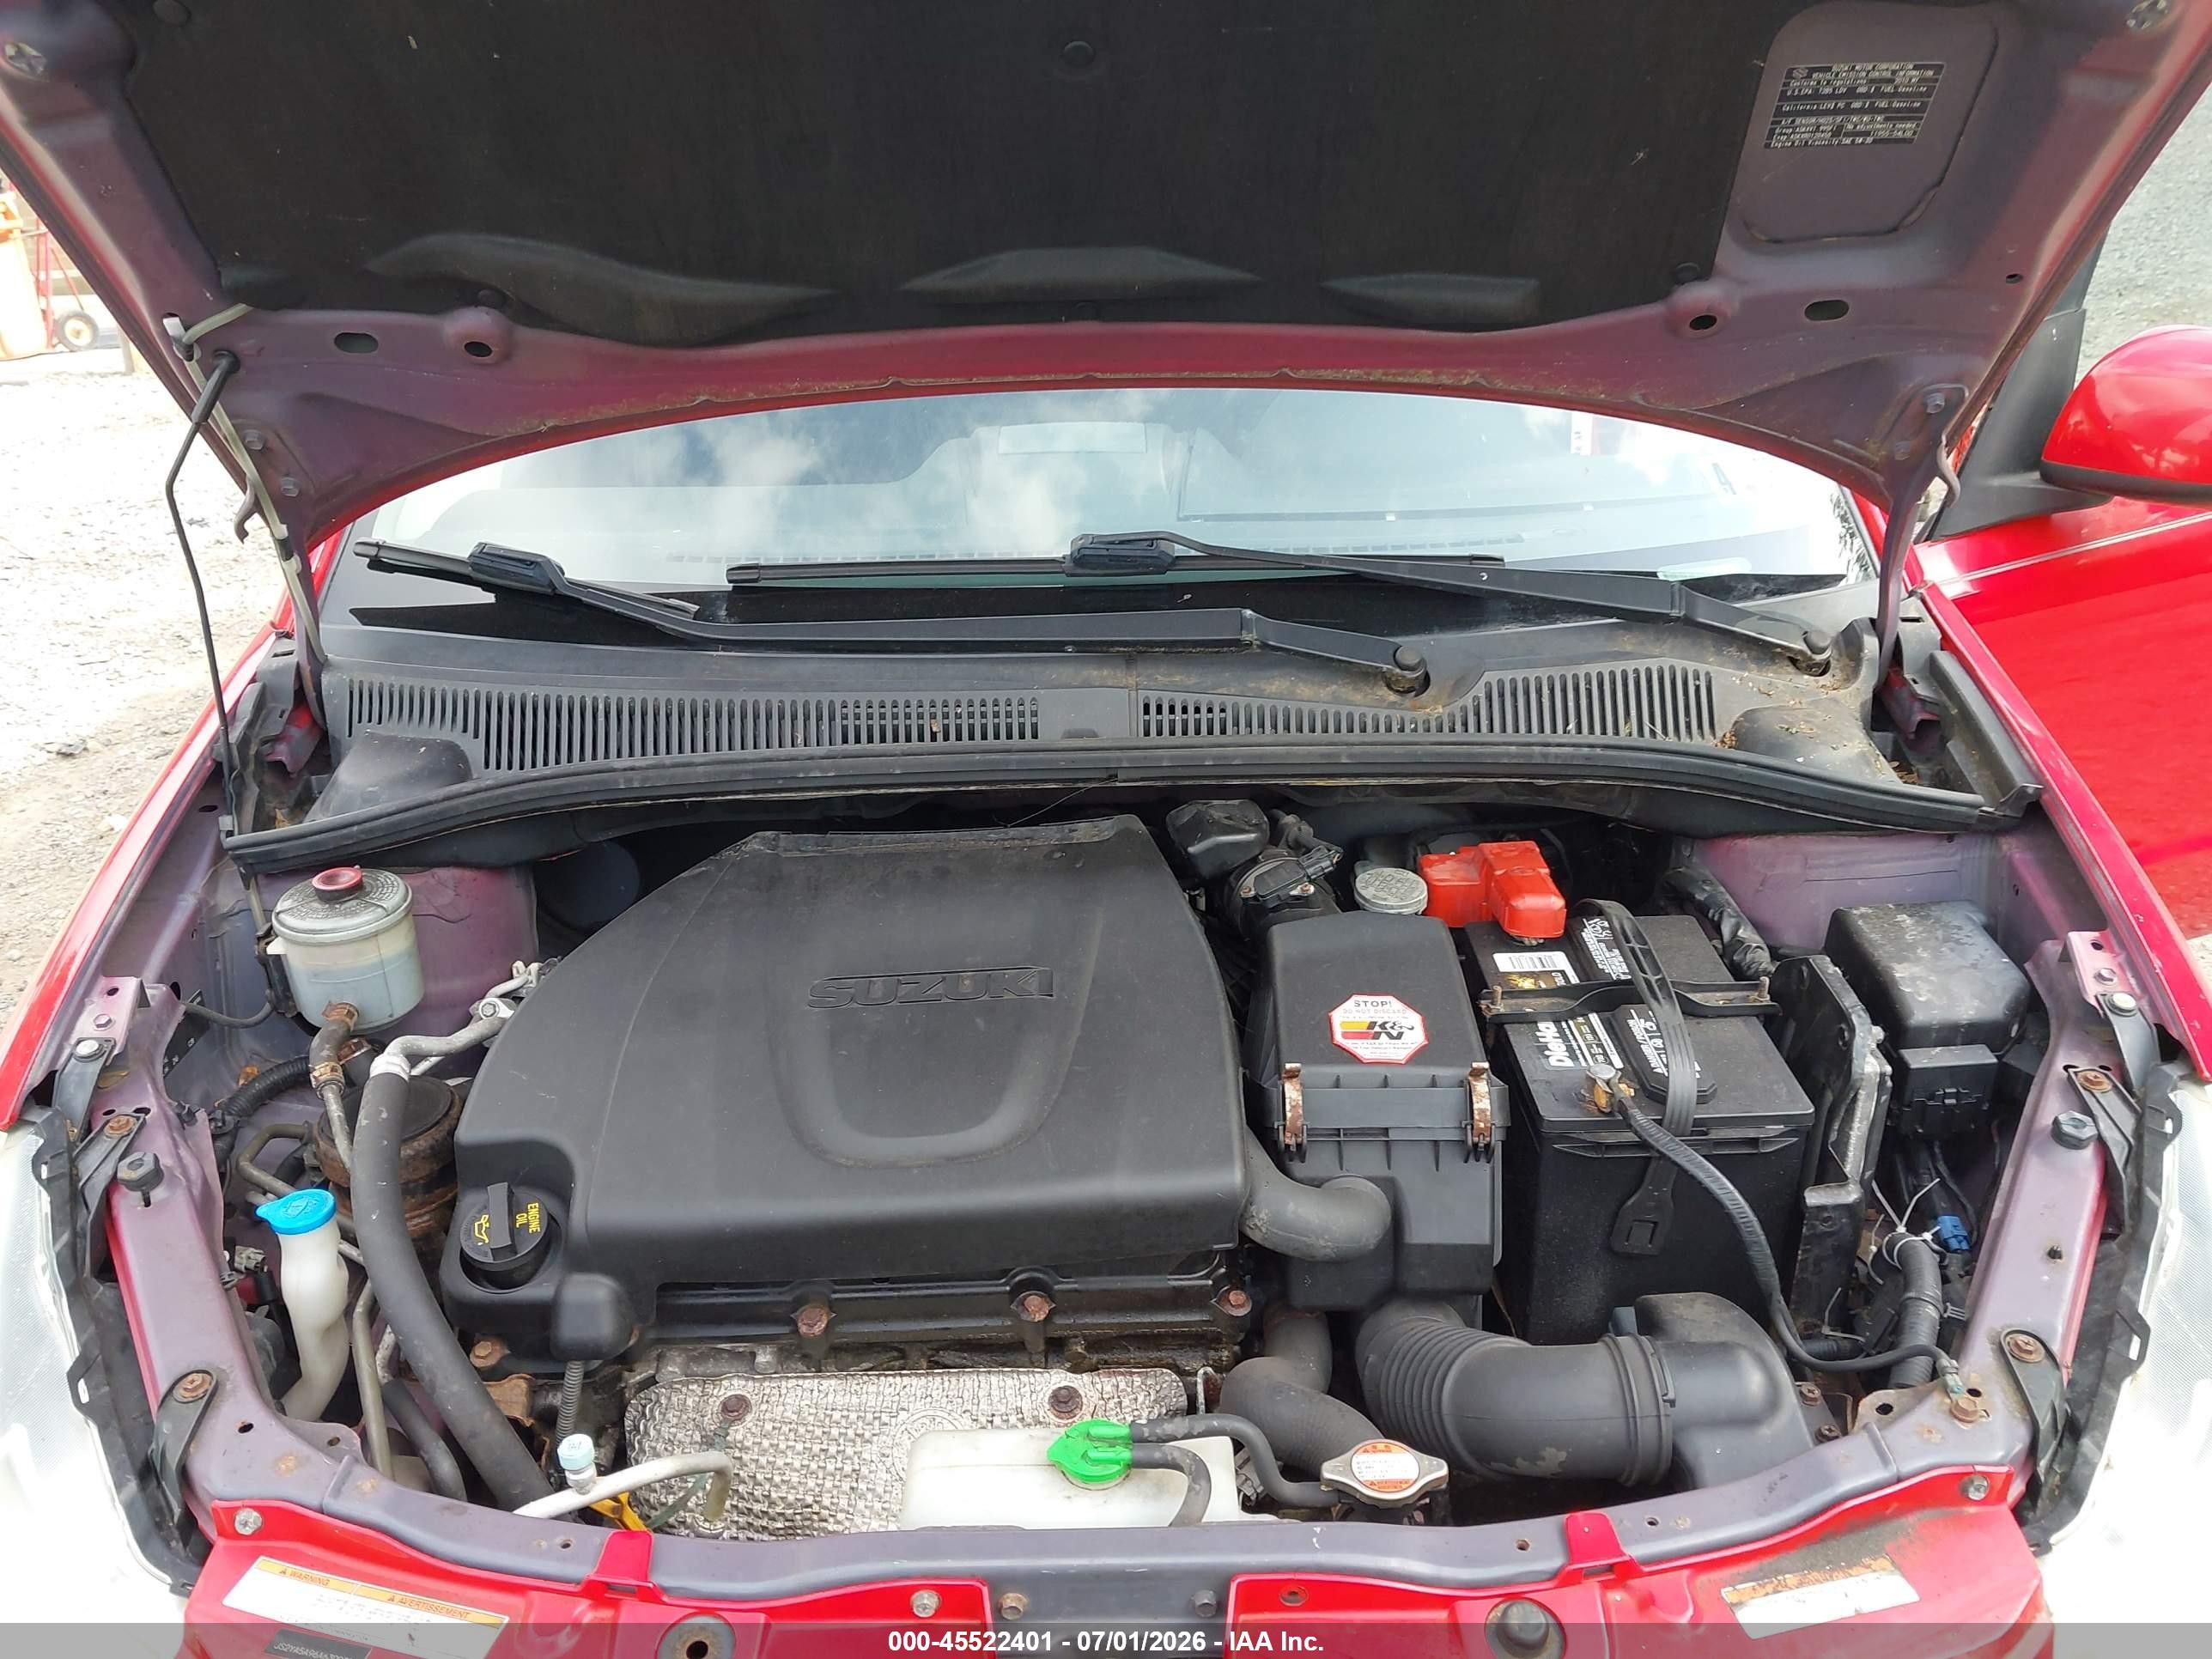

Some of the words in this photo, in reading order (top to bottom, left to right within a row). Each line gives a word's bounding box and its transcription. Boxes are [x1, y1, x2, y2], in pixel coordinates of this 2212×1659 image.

[808, 967, 1054, 1008] SUZUKI
[515, 1212, 527, 1229] OIL
[527, 1202, 540, 1234] ENGINE
[289, 1569, 330, 1587] WARNING
[398, 1597, 471, 1620] AVERTISSEMENT
